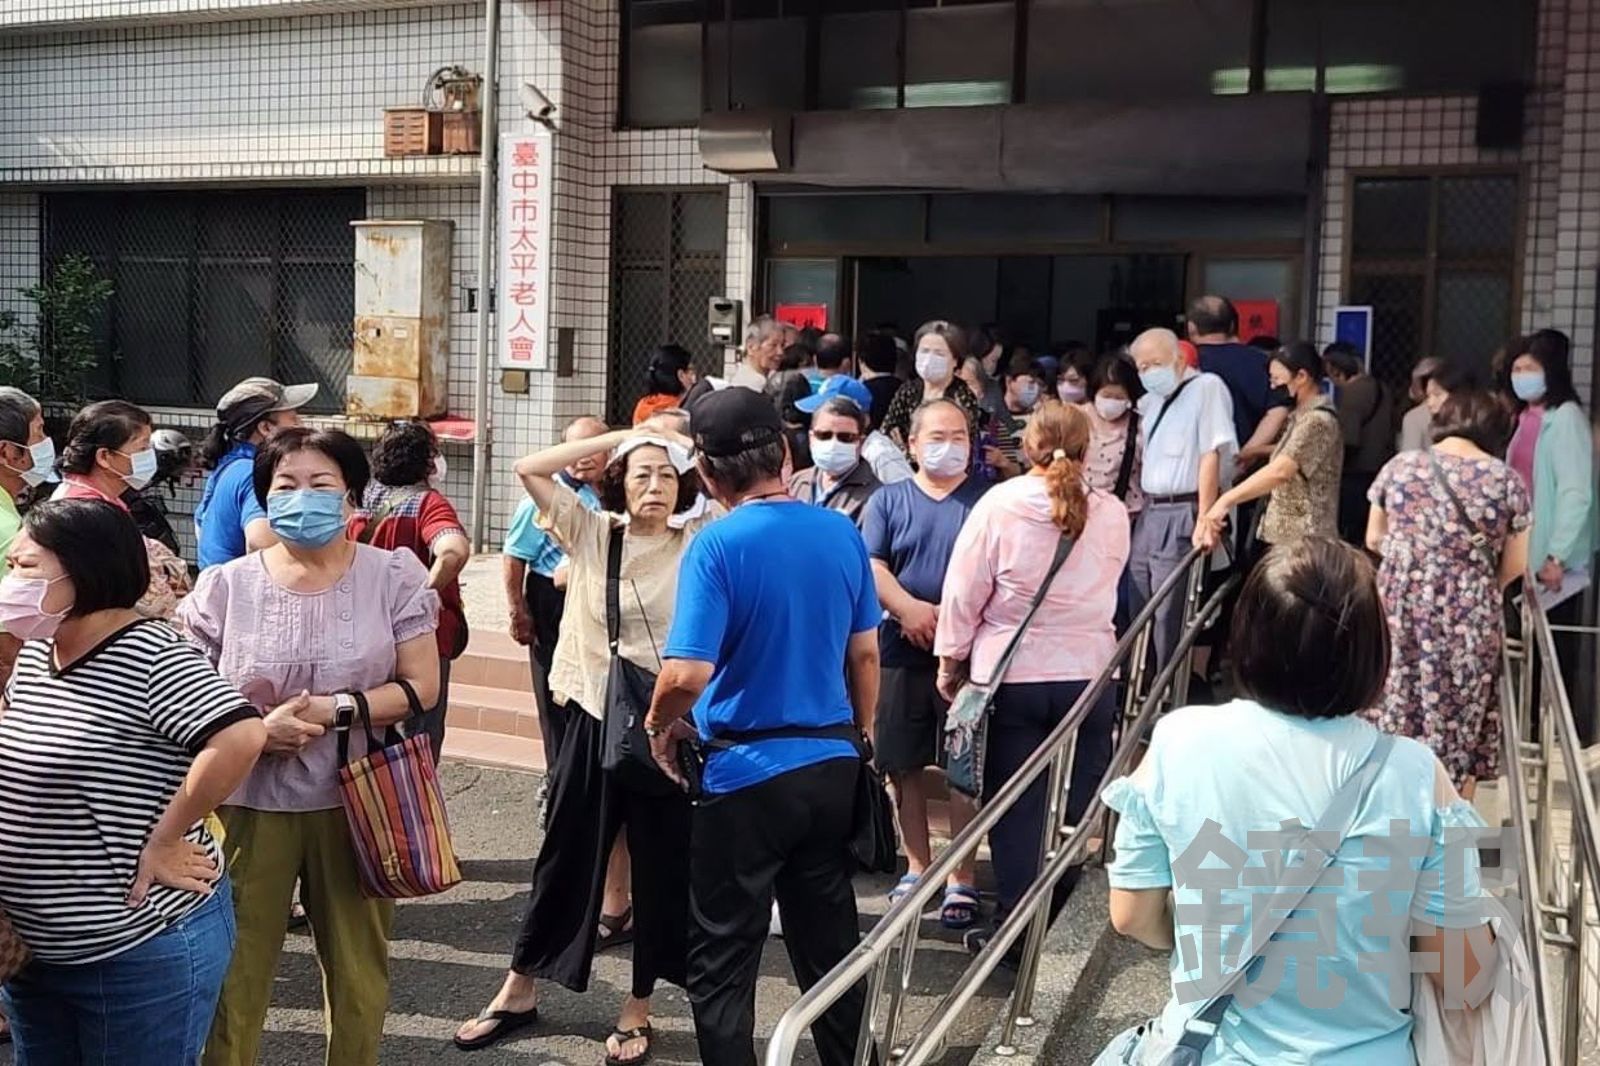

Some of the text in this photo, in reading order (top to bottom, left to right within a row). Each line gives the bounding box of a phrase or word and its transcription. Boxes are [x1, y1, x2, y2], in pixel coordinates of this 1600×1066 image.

[508, 141, 540, 362] 臺中市太平老人會
